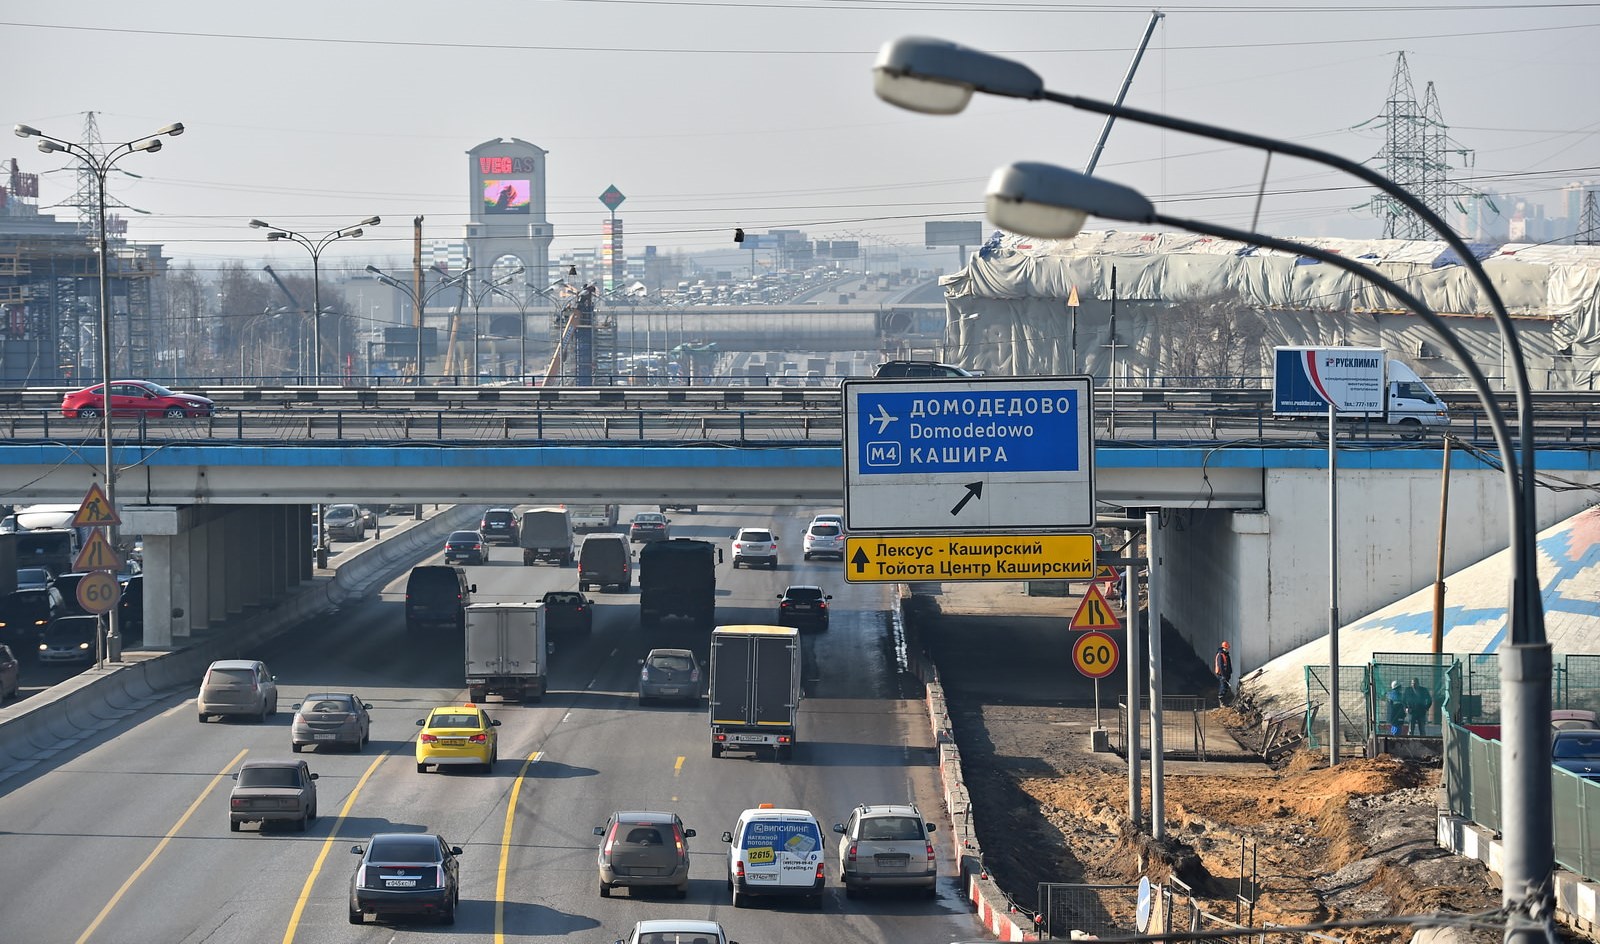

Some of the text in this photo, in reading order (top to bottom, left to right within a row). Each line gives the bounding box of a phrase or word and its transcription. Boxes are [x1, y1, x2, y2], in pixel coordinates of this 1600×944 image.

[480, 156, 534, 174] VEGAS
[1335, 358, 1379, 369] РУСКЛИМАТ
[910, 397, 1070, 418] ДОМОДЕДОВО
[910, 422, 1034, 439] Domodedowo
[910, 446, 1008, 464] КАШИРА
[876, 543, 934, 559] Лексус
[949, 541, 1043, 558] Каширский
[876, 557, 1092, 577] Тойота Центр Каширский
[87, 584, 112, 601] 60
[1083, 646, 1110, 665] 60
